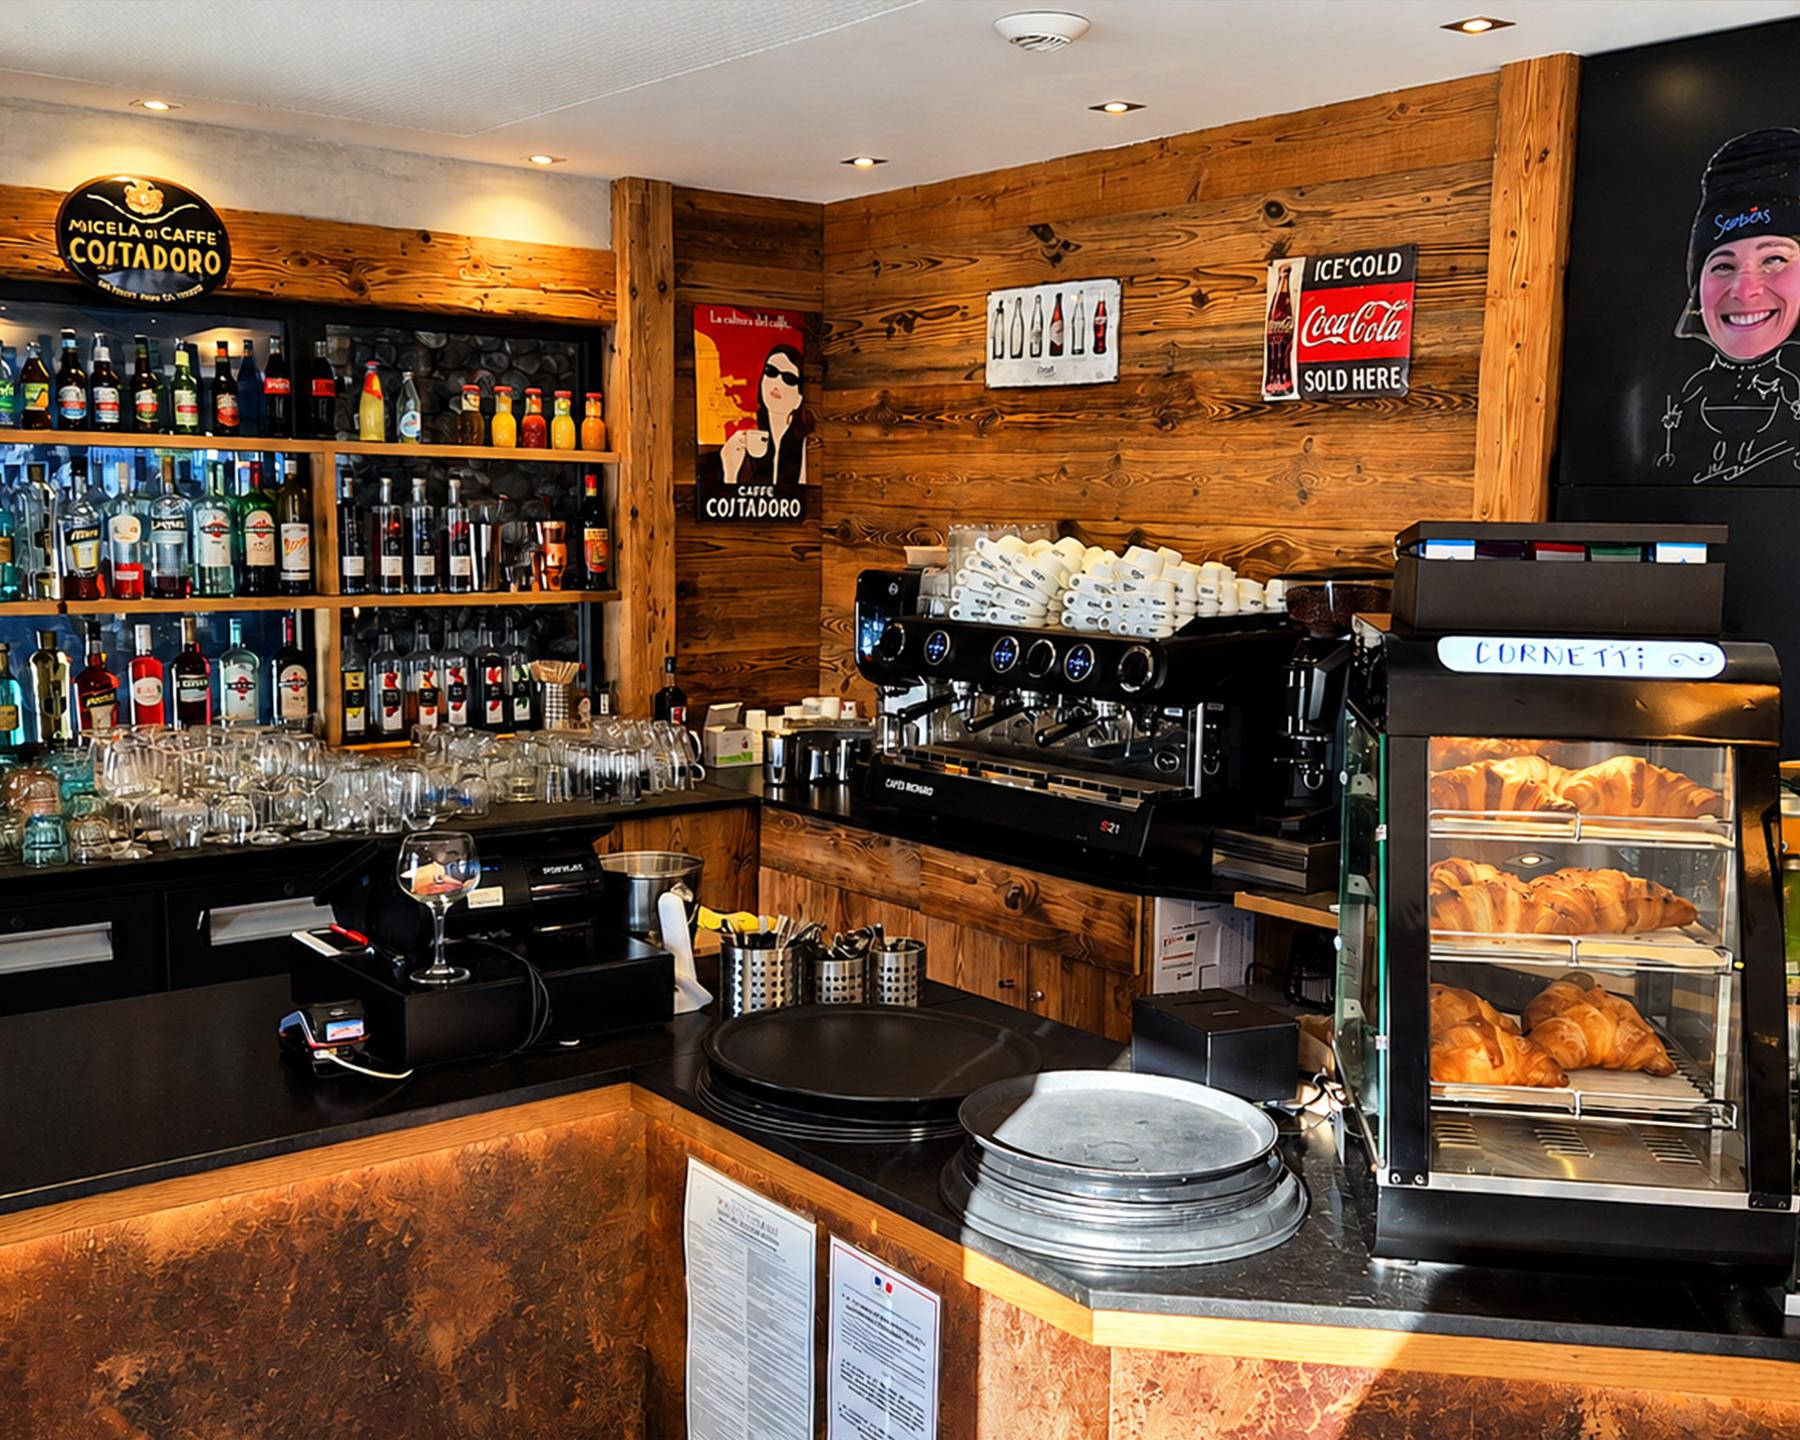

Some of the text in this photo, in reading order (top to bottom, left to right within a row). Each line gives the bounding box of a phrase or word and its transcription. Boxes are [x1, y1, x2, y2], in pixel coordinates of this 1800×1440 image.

[69, 237, 222, 275] COSTADORO
[1304, 369, 1348, 392] SOLD
[1352, 366, 1401, 390] HERE
[705, 498, 801, 518] COSTADORO
